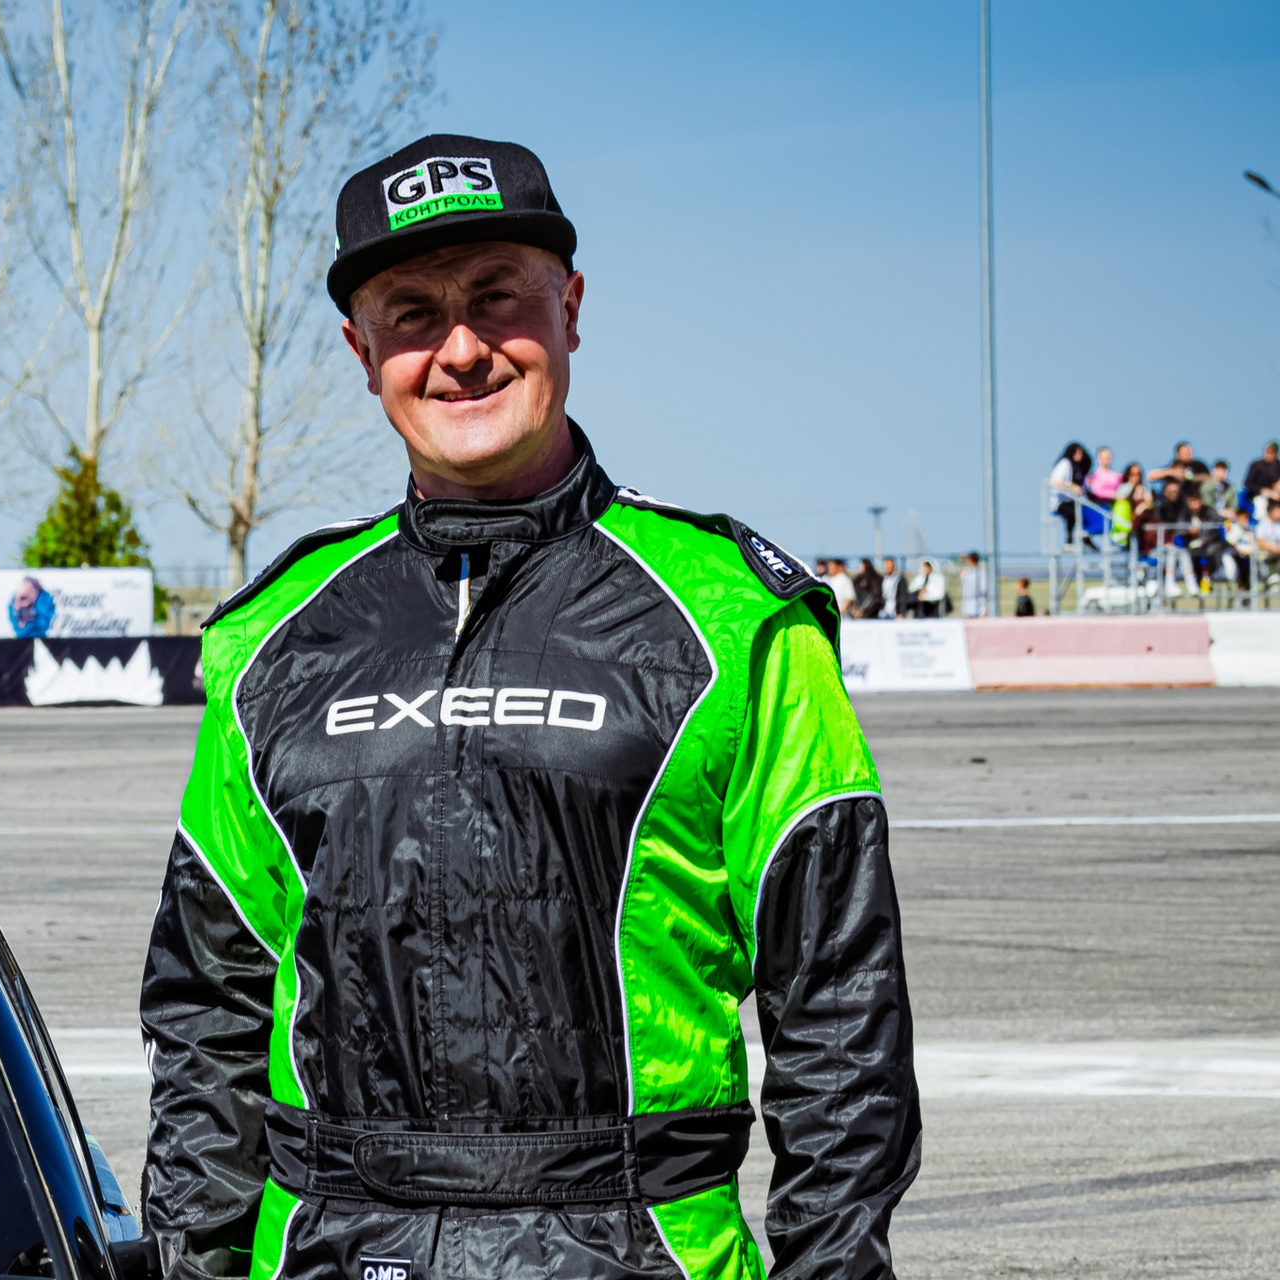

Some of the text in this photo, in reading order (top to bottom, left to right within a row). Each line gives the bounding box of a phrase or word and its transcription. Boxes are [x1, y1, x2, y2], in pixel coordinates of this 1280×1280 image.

[387, 160, 493, 205] GPS
[394, 193, 497, 226] КОНТРОЛЬ
[751, 536, 793, 576] OMP
[325, 686, 608, 736] EXEED
